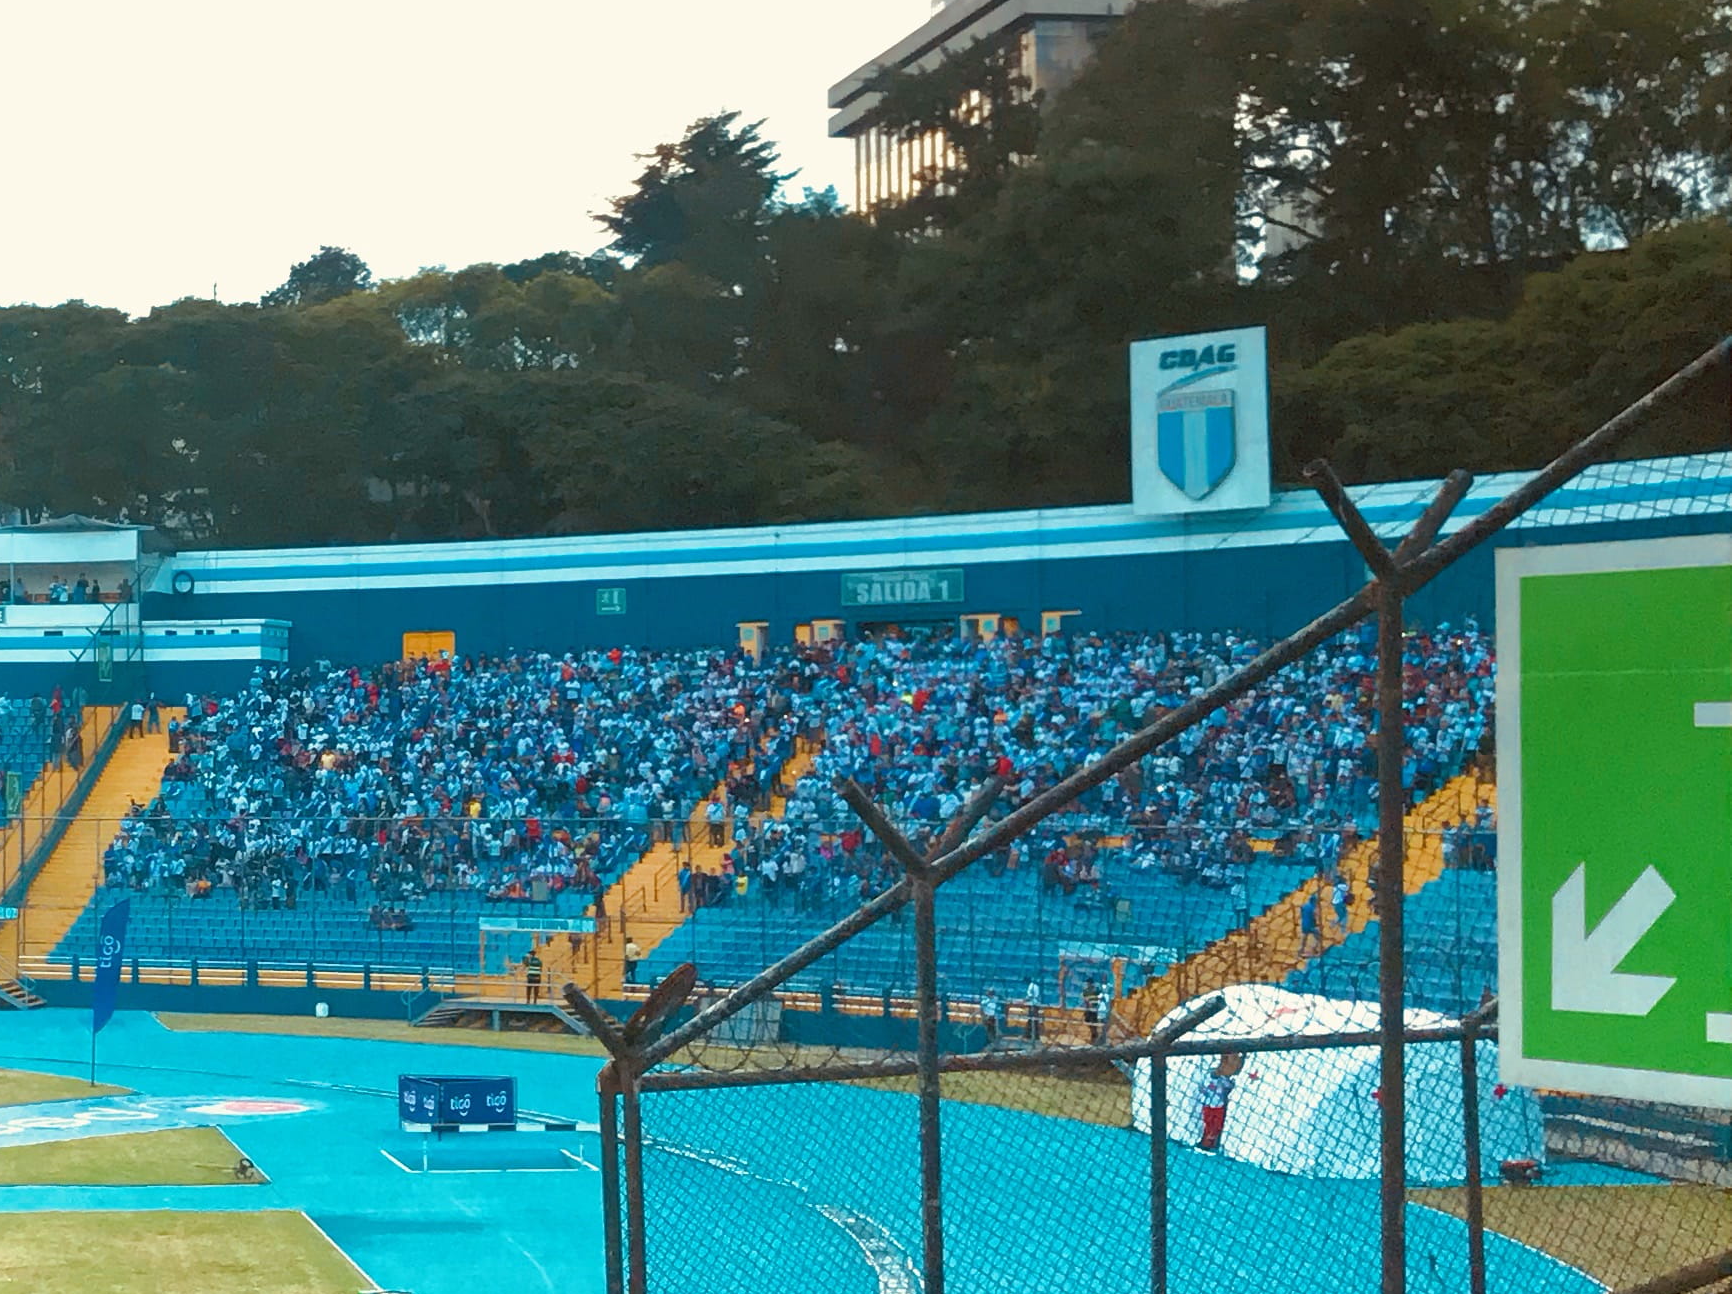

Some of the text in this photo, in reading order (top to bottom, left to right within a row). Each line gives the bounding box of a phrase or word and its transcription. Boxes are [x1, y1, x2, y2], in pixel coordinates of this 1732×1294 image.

[857, 580, 949, 603] SALIDA 1
[100, 935, 121, 968] tigo
[450, 1094, 471, 1116] tigo
[486, 1091, 506, 1112] tigo
